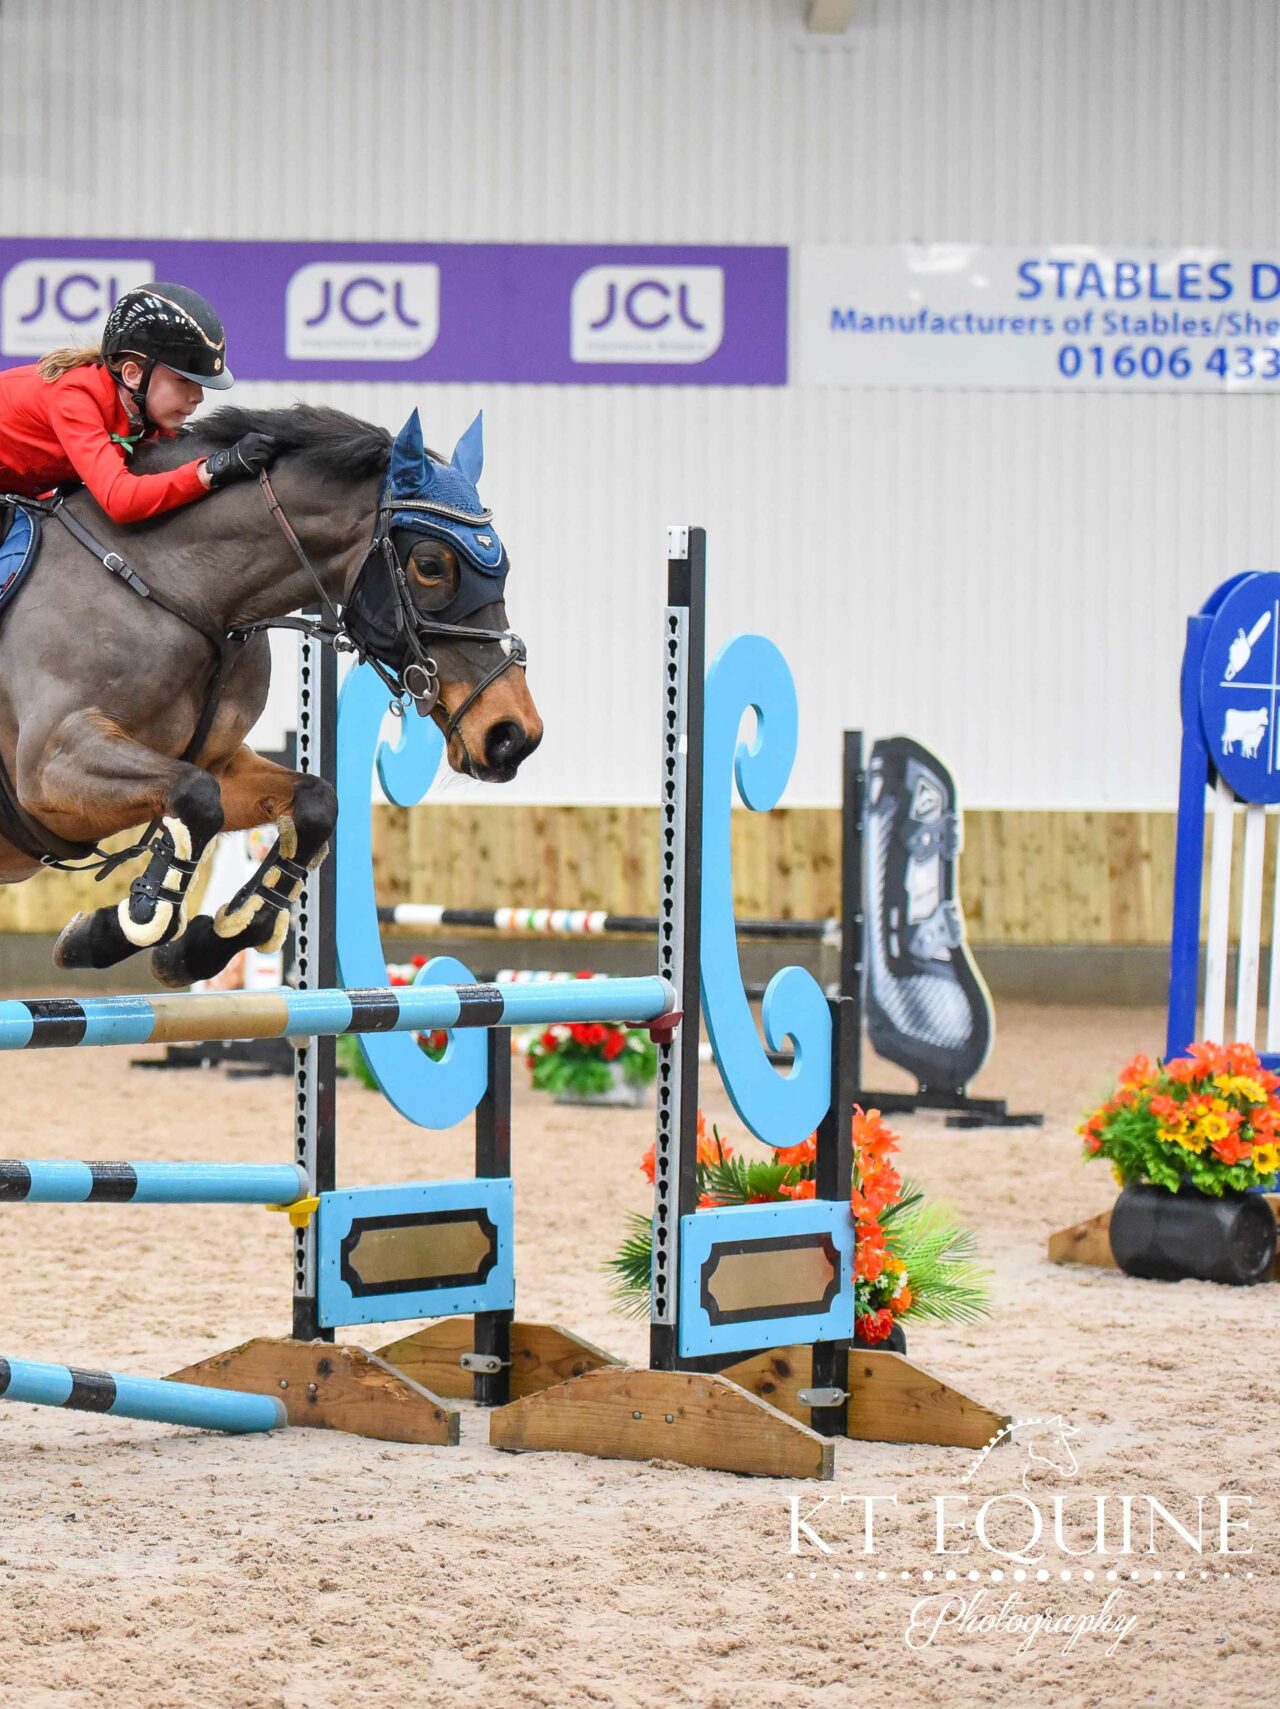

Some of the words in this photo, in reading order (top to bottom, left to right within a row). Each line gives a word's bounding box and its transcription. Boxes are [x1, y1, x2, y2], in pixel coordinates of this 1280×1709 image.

[1017, 260, 1235, 301] STABLES
[305, 278, 420, 327] JCL
[590, 281, 705, 331] JCL
[830, 308, 1054, 335] Manufacturers
[1064, 309, 1094, 335] of
[1058, 344, 1193, 380] 01606
